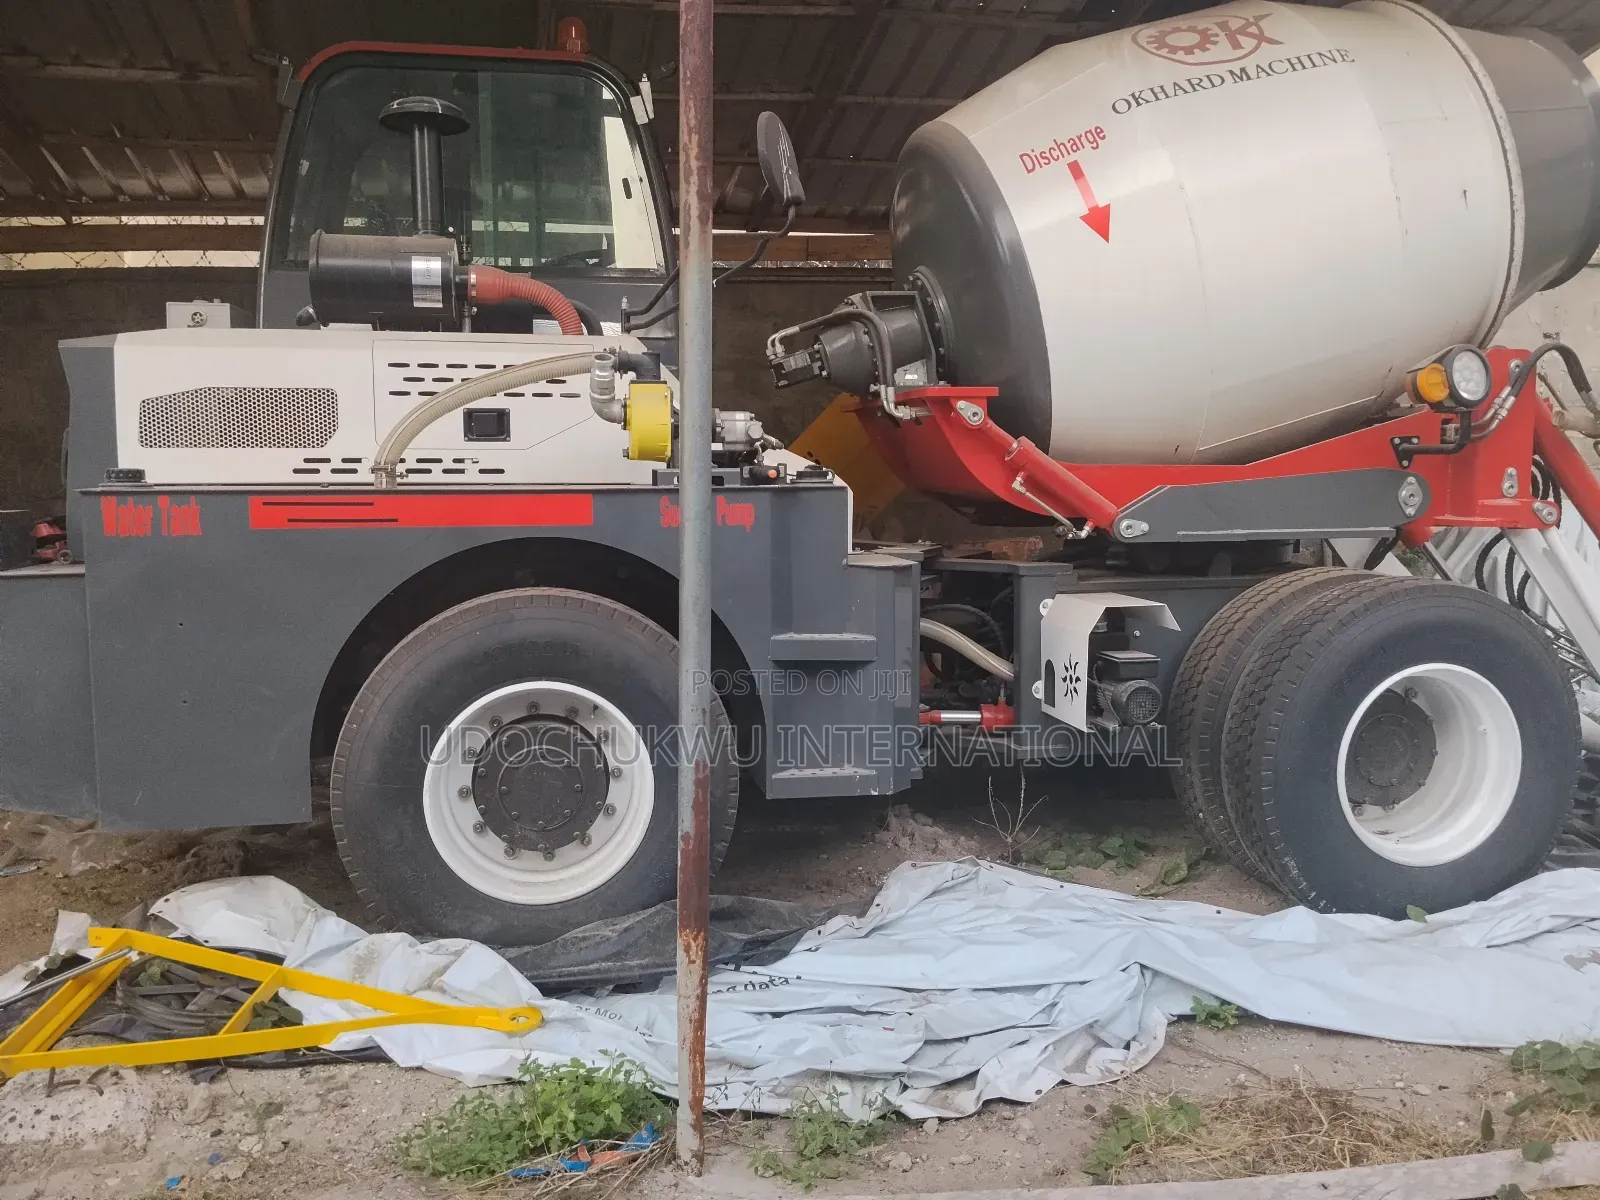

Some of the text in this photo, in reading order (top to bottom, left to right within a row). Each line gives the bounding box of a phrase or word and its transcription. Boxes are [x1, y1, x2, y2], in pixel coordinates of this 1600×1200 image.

[1111, 48, 1356, 115] OKHARD MACHINE
[1018, 125, 1107, 174] Discharge
[101, 495, 203, 537] Water Tank
[716, 495, 755, 533] Pump
